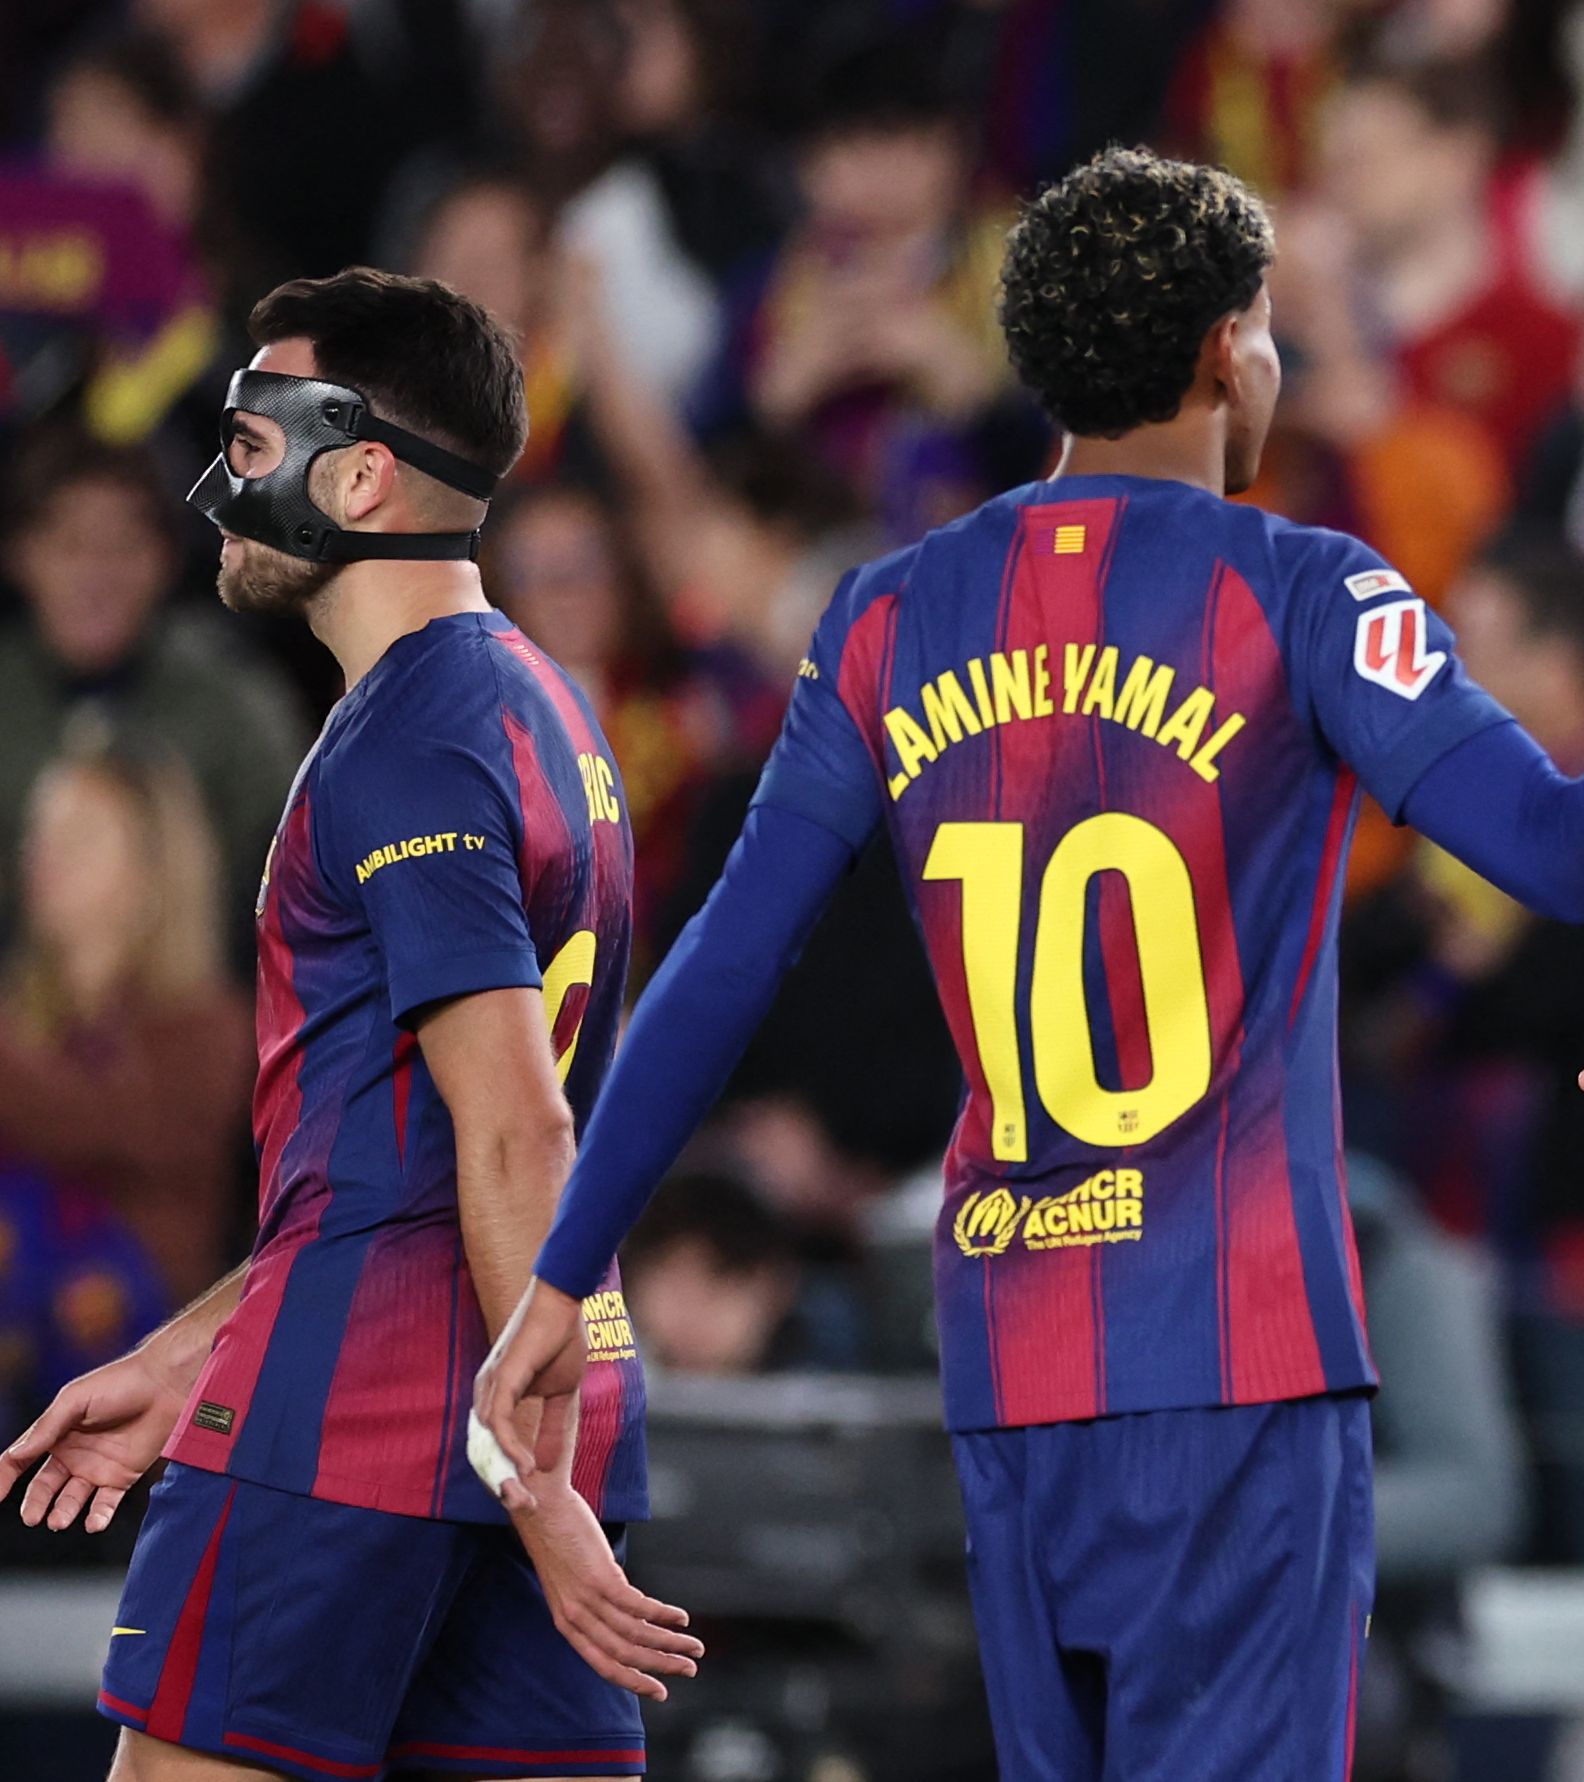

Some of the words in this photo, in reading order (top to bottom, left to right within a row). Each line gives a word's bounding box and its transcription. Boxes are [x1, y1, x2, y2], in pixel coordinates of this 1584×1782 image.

[1062, 642, 1246, 783] YAMAL
[578, 752, 620, 827] RIC
[355, 832, 458, 885] AMBILIGHT
[462, 833, 485, 850] tv
[922, 811, 1213, 1163] 10
[1022, 1199, 1143, 1239] ACNUR
[582, 1291, 626, 1322] NHCR
[588, 1319, 634, 1350] CNUR
